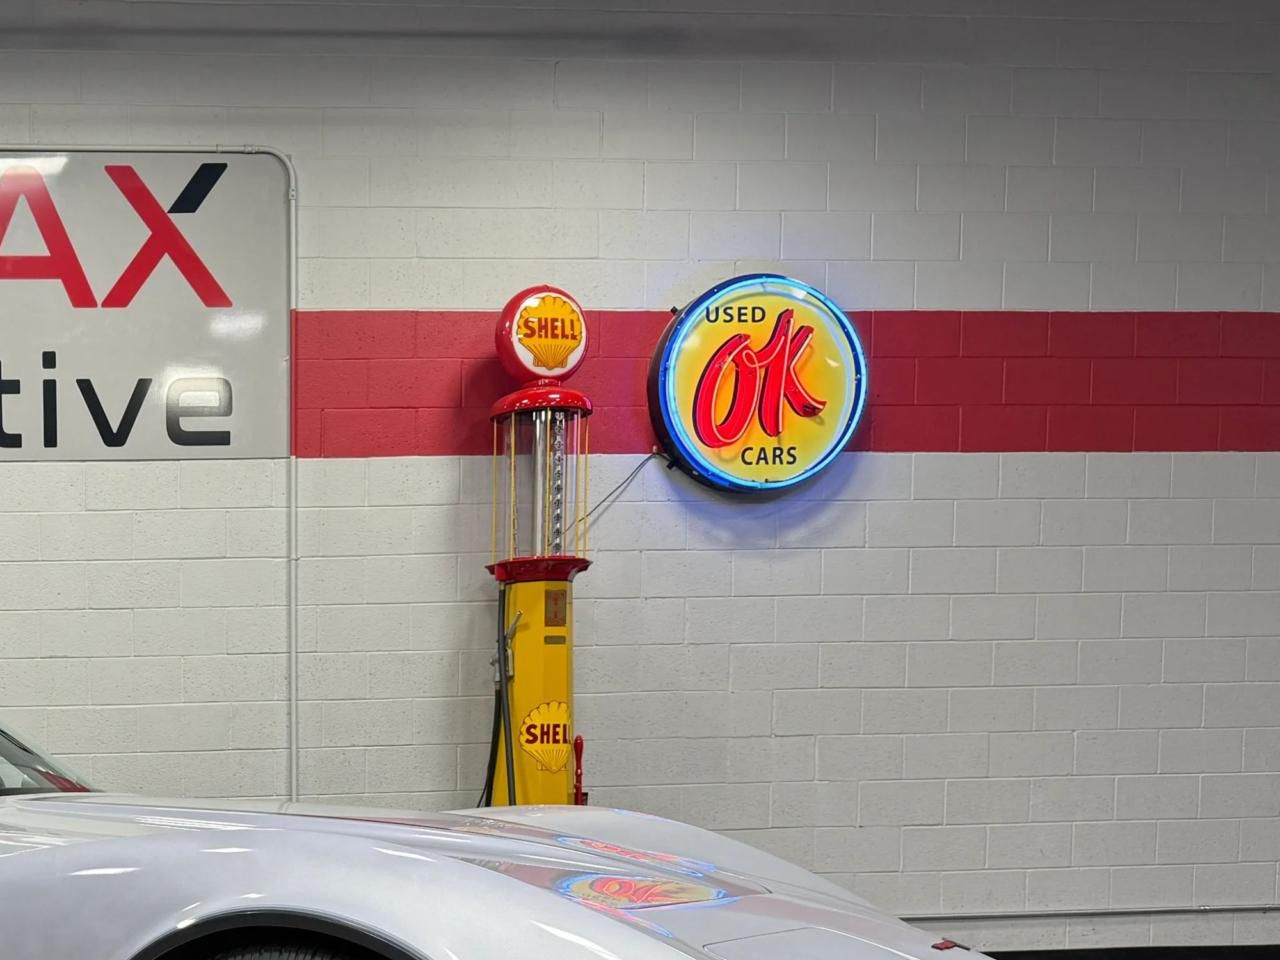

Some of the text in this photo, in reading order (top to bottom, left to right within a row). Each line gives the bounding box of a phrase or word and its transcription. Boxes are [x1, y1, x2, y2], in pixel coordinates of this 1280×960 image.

[705, 306, 766, 323] USED
[523, 317, 578, 340] SHELL
[692, 308, 827, 448] OK
[741, 447, 797, 465] CARS
[525, 723, 571, 745] SHEL
